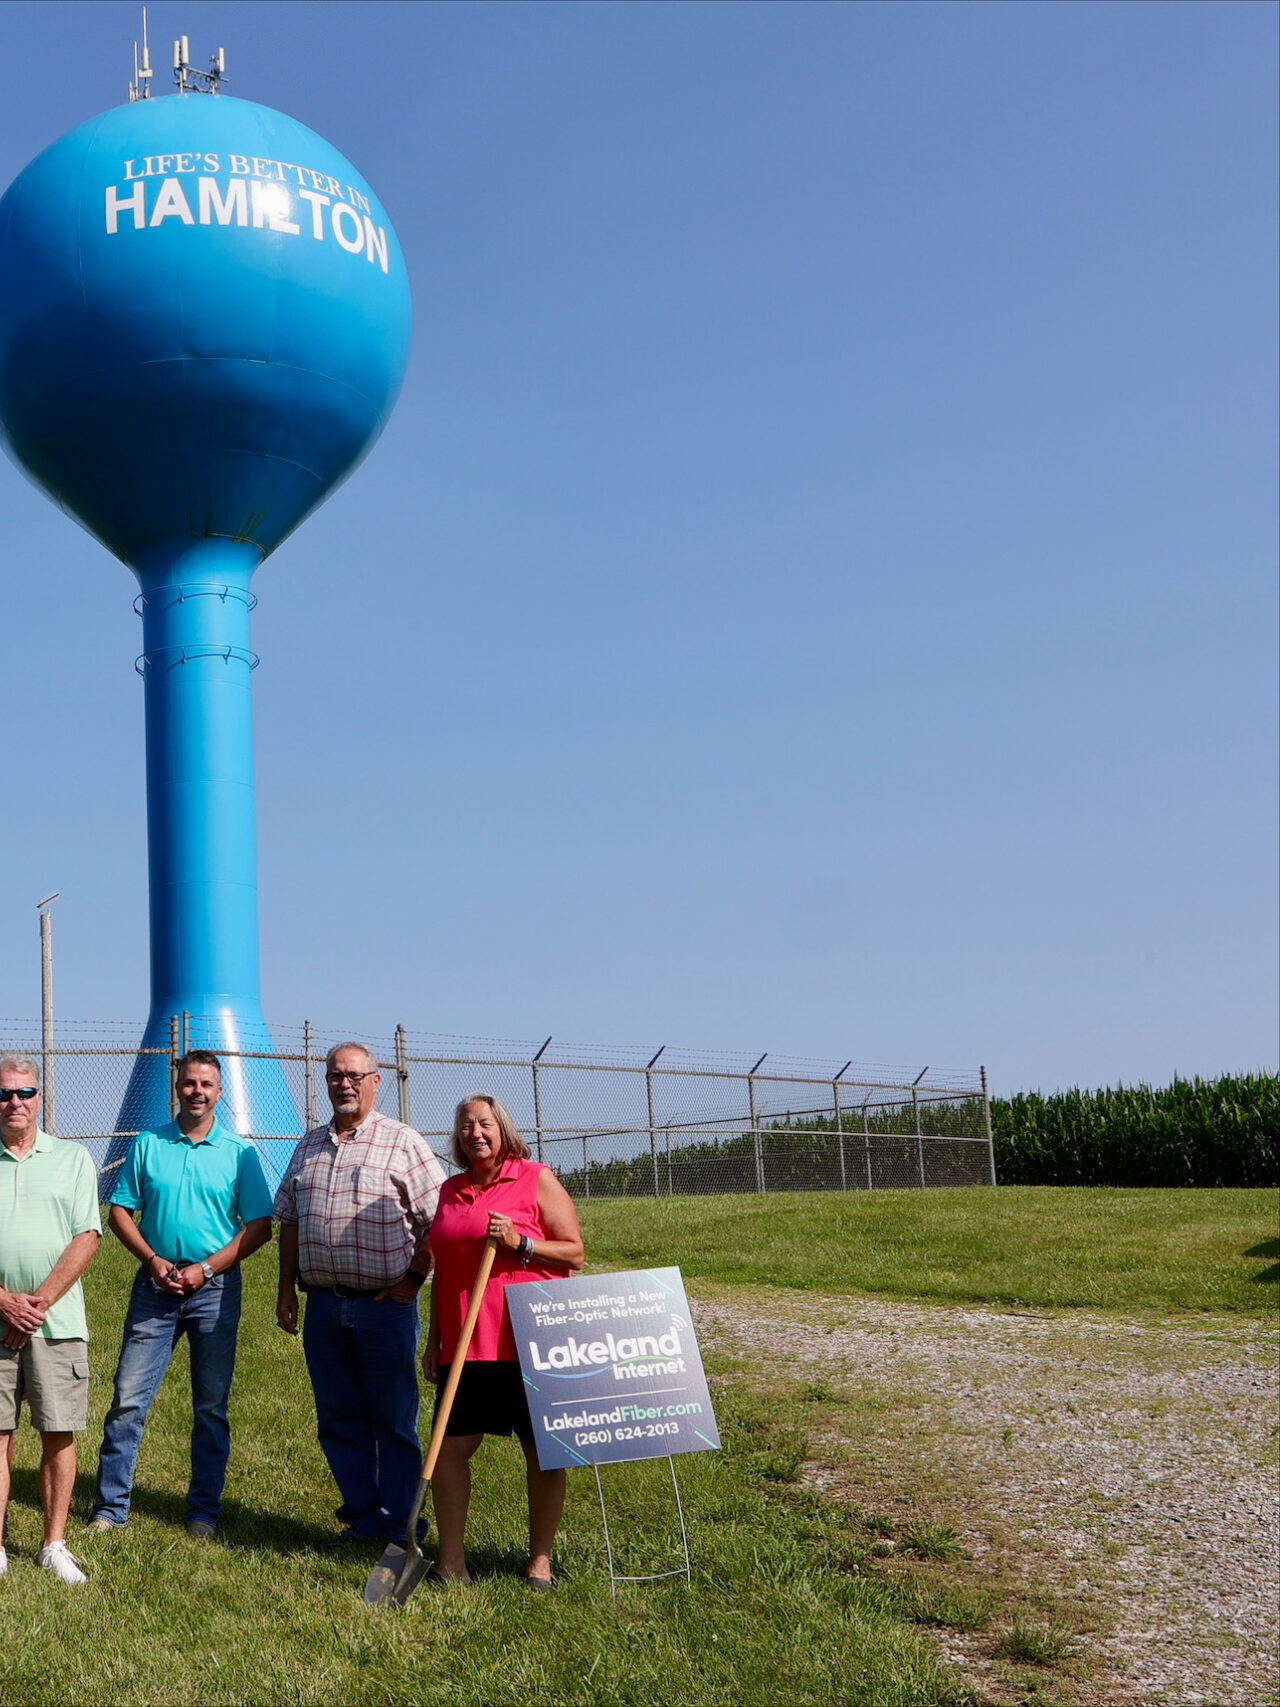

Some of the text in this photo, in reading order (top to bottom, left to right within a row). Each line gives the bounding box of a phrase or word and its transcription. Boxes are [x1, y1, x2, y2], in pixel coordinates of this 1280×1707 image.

[123, 153, 372, 216] LIFE'S BETTER IN
[105, 177, 389, 275] HAMILTON
[529, 1290, 667, 1315] We're Installing a New
[535, 1303, 667, 1327] Fiber-Optic Network!
[529, 1326, 682, 1371] Lakeland
[612, 1357, 687, 1381] Internet
[543, 1402, 703, 1432] LakelandFiber.com
[575, 1422, 680, 1447] (260) 624-2013
